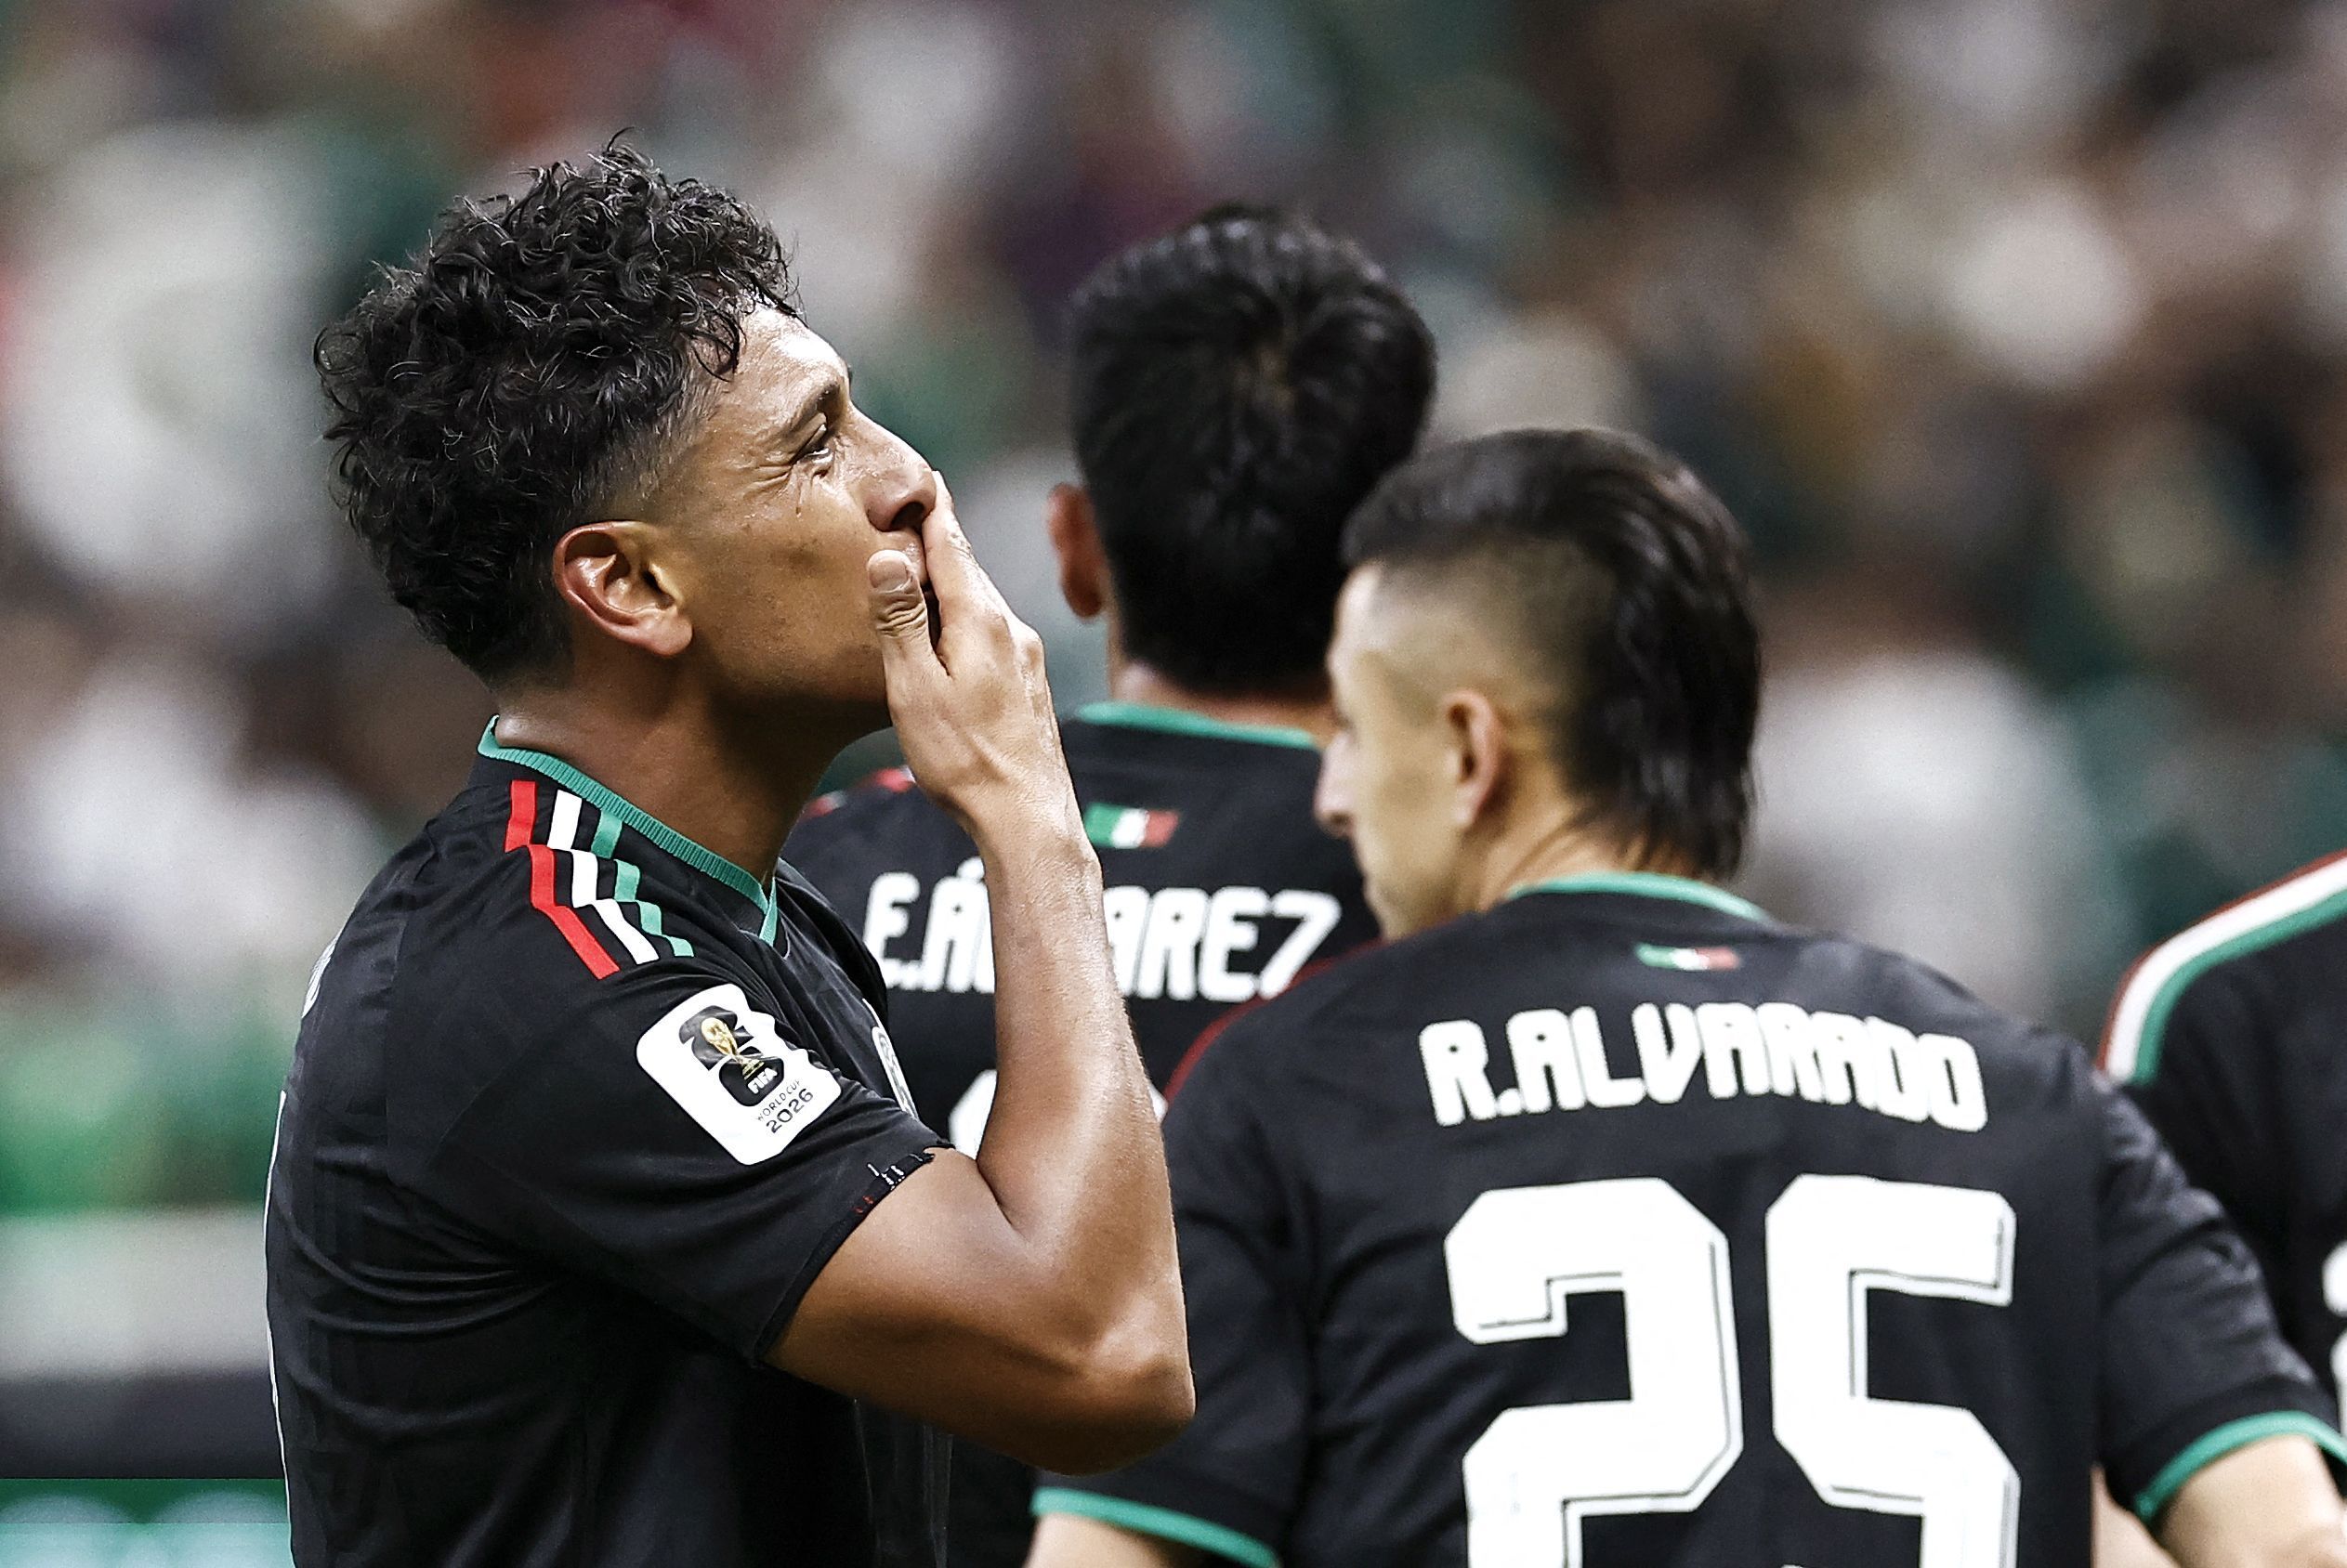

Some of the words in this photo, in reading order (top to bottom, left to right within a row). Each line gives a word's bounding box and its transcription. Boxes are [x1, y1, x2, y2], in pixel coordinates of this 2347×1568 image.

[862, 856, 1342, 1002] E.ÁAREZ
[747, 1067, 778, 1094] FIFA
[756, 1092, 787, 1122] WORLD
[786, 1080, 800, 1094] CUP
[767, 1088, 813, 1133] 2026
[1419, 1001, 1988, 1132] R.ALVARADO
[1445, 1173, 2021, 1568] 25
